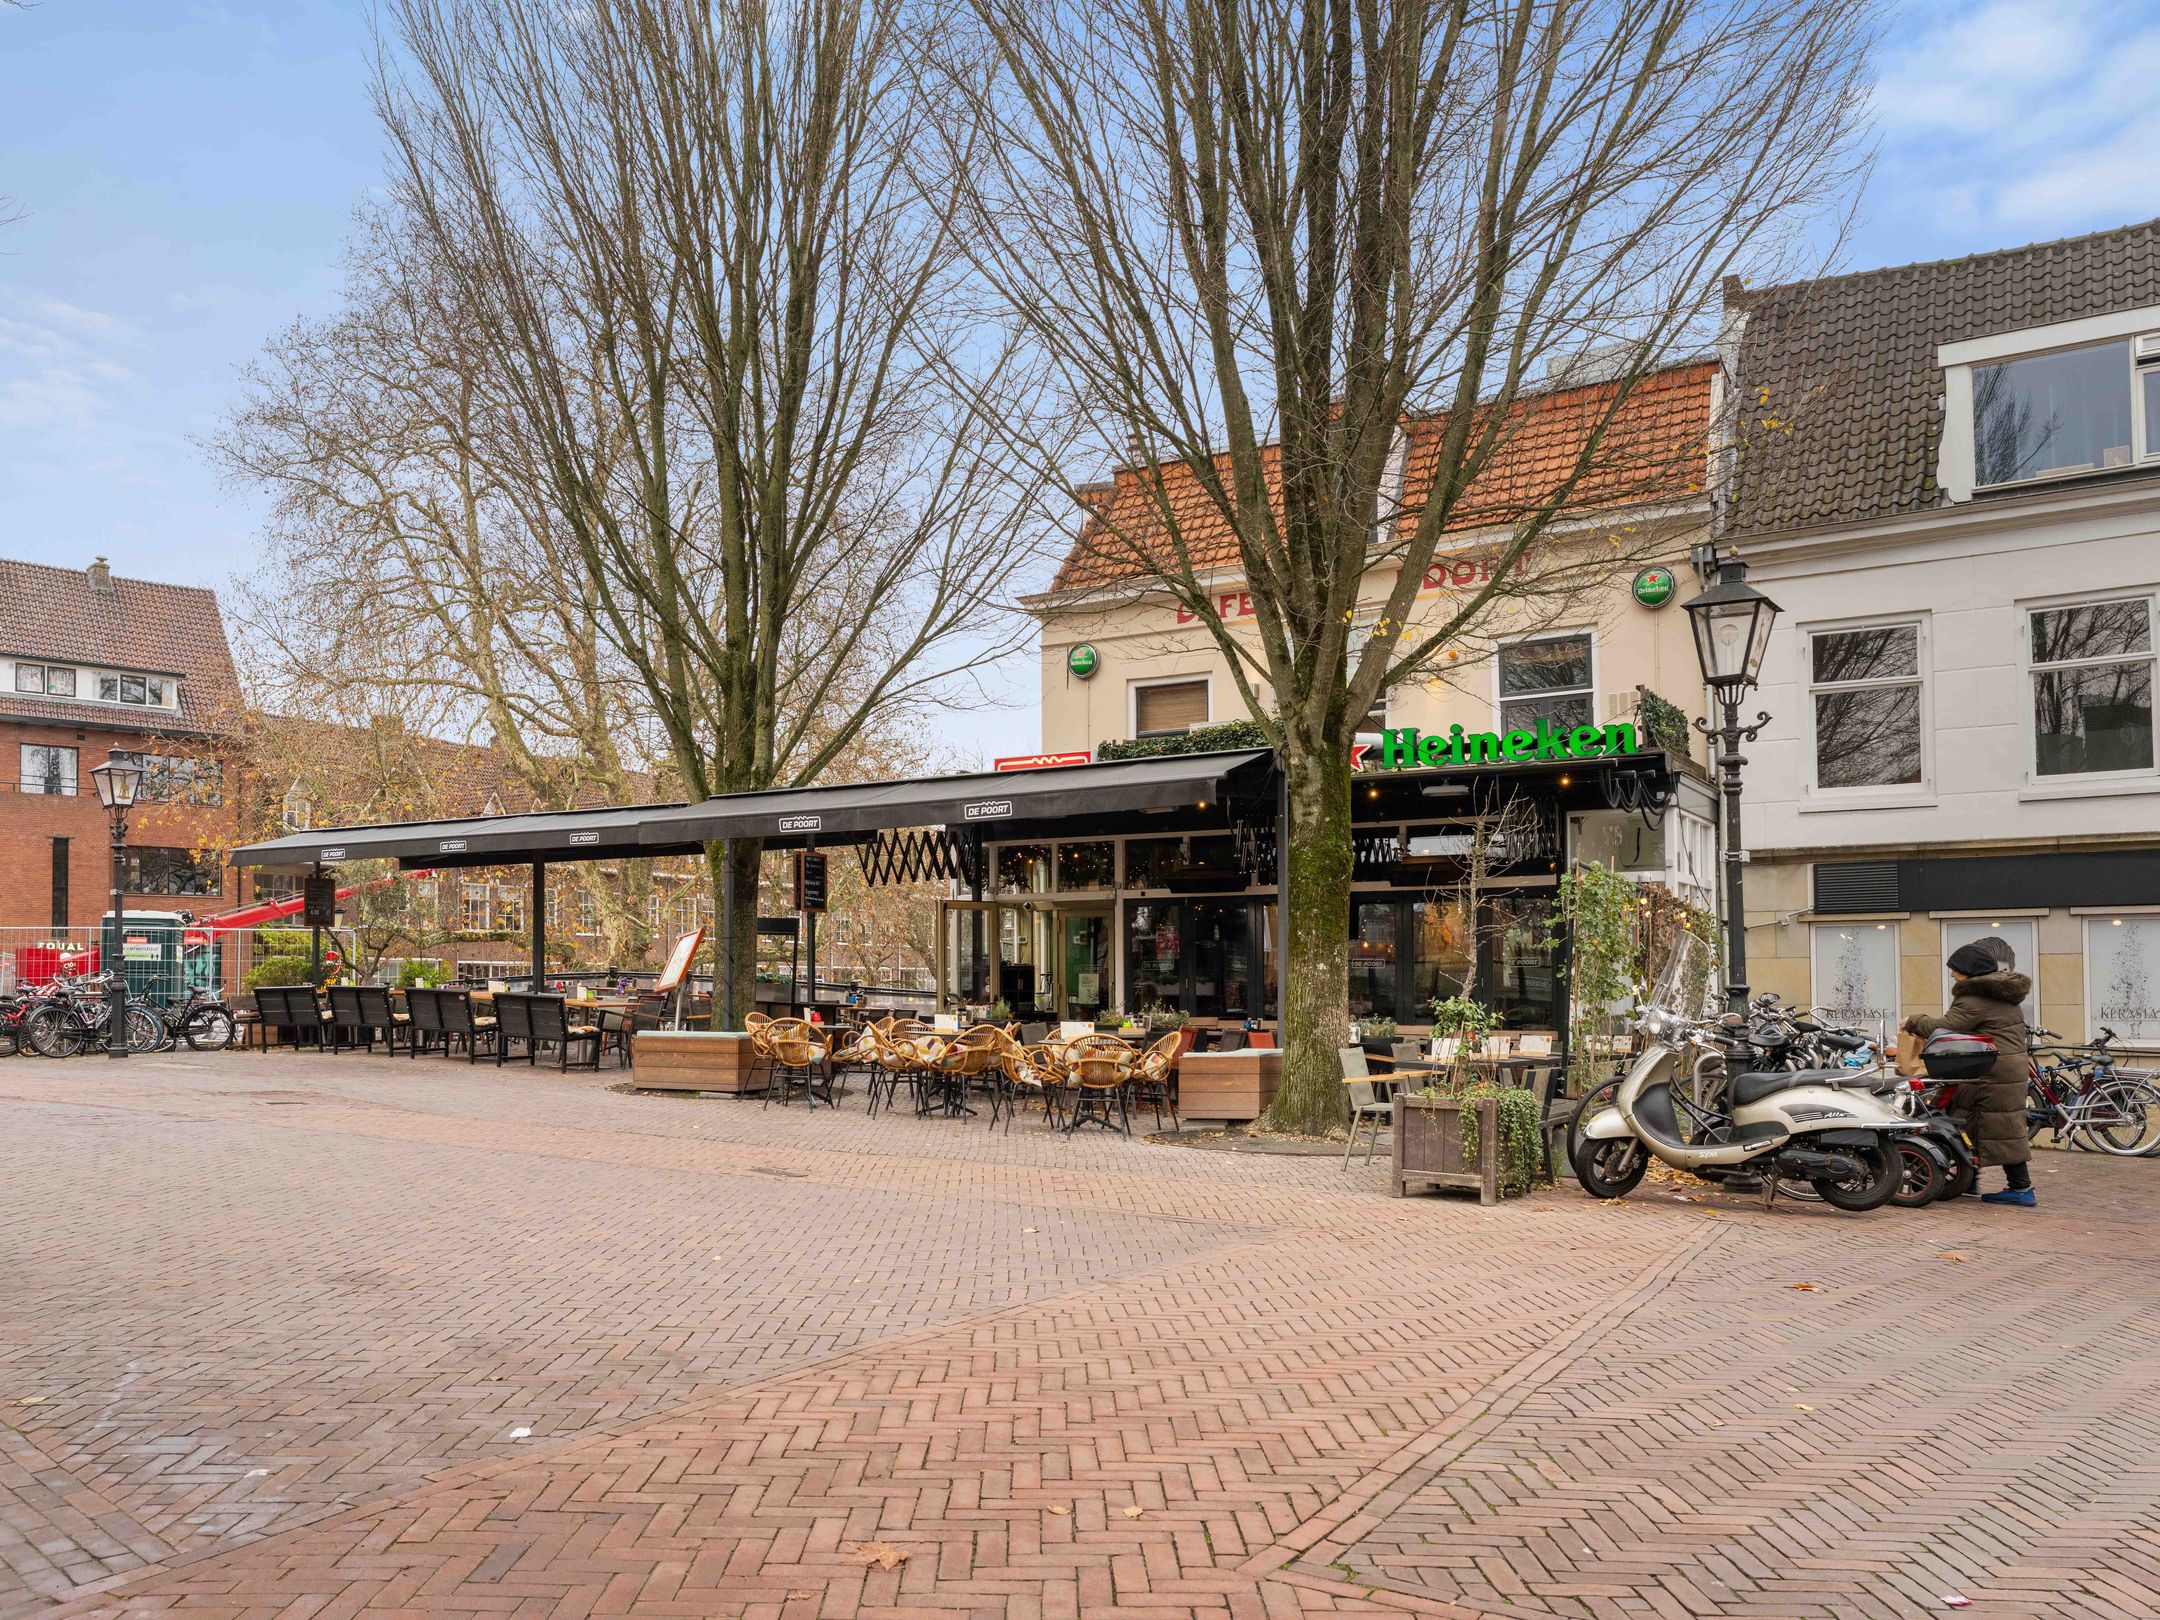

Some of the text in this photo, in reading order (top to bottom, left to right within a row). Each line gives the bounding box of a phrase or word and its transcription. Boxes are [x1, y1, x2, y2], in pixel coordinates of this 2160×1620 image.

[1176, 551, 1532, 625] CFE OORT
[1379, 717, 1640, 769] Heineken
[968, 804, 1009, 816] DE POORT
[782, 819, 818, 829] DE POORT
[1698, 1151, 1718, 1159] SYM
